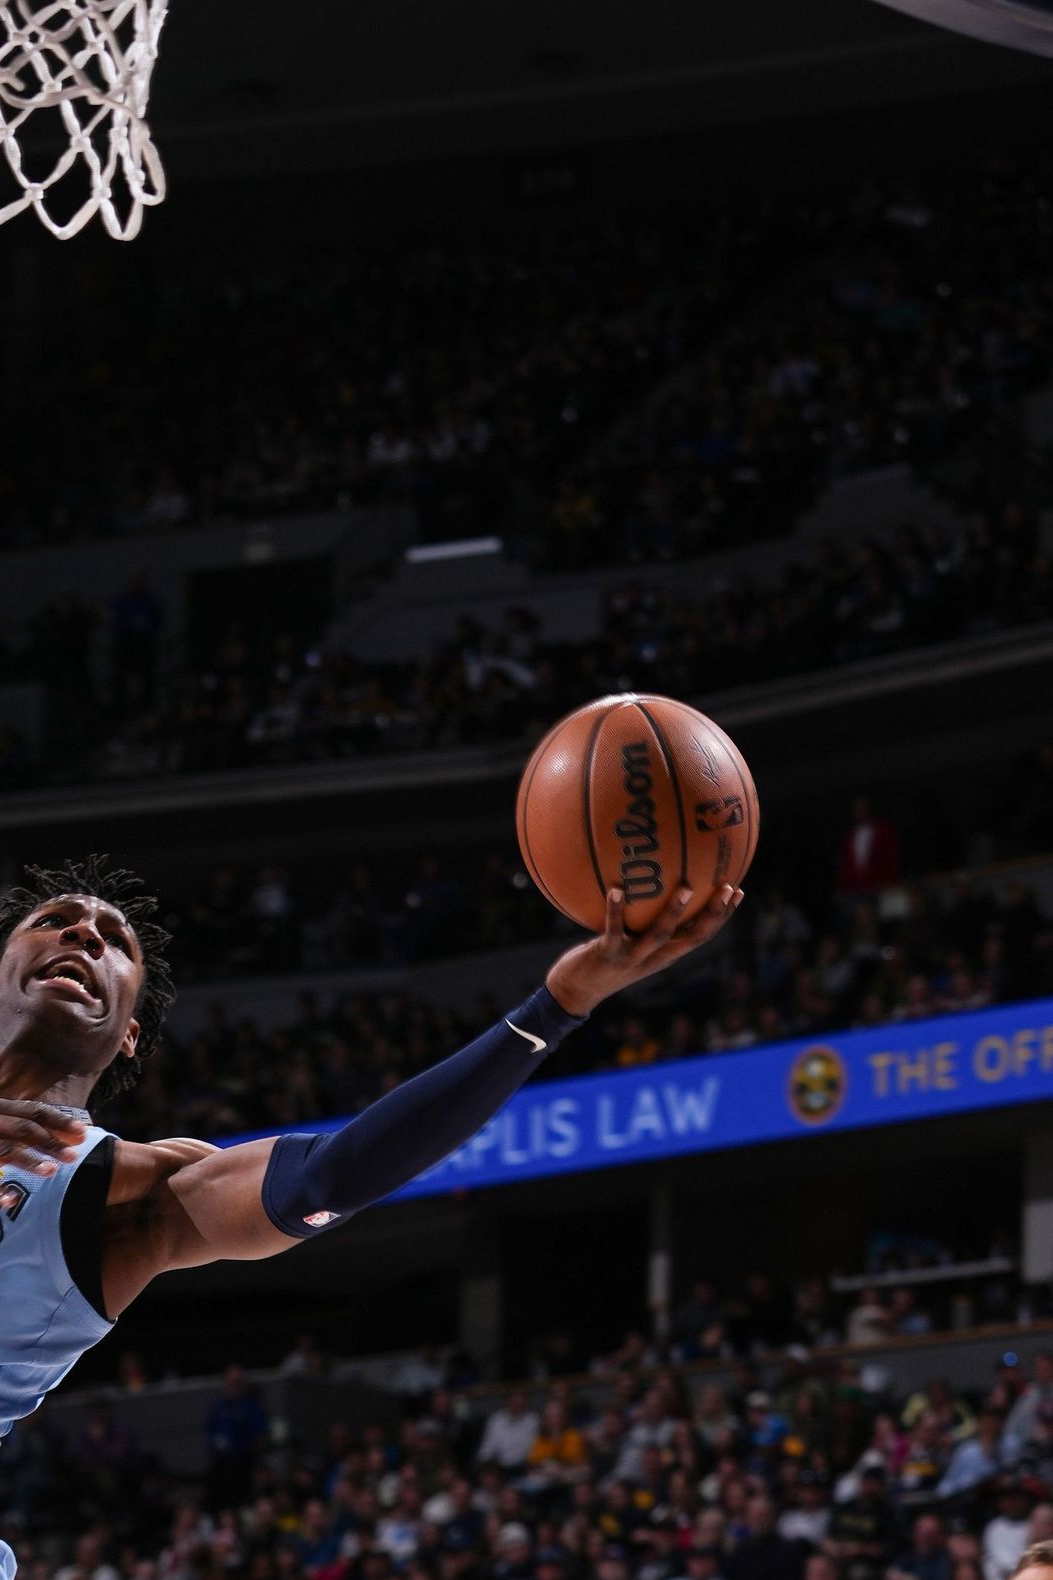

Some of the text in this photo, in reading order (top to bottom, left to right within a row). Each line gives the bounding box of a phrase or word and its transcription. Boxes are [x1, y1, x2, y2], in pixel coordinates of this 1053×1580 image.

[615, 742, 665, 904] Wilson
[868, 1042, 958, 1098] THE
[450, 1075, 720, 1169] PLIS LAW
